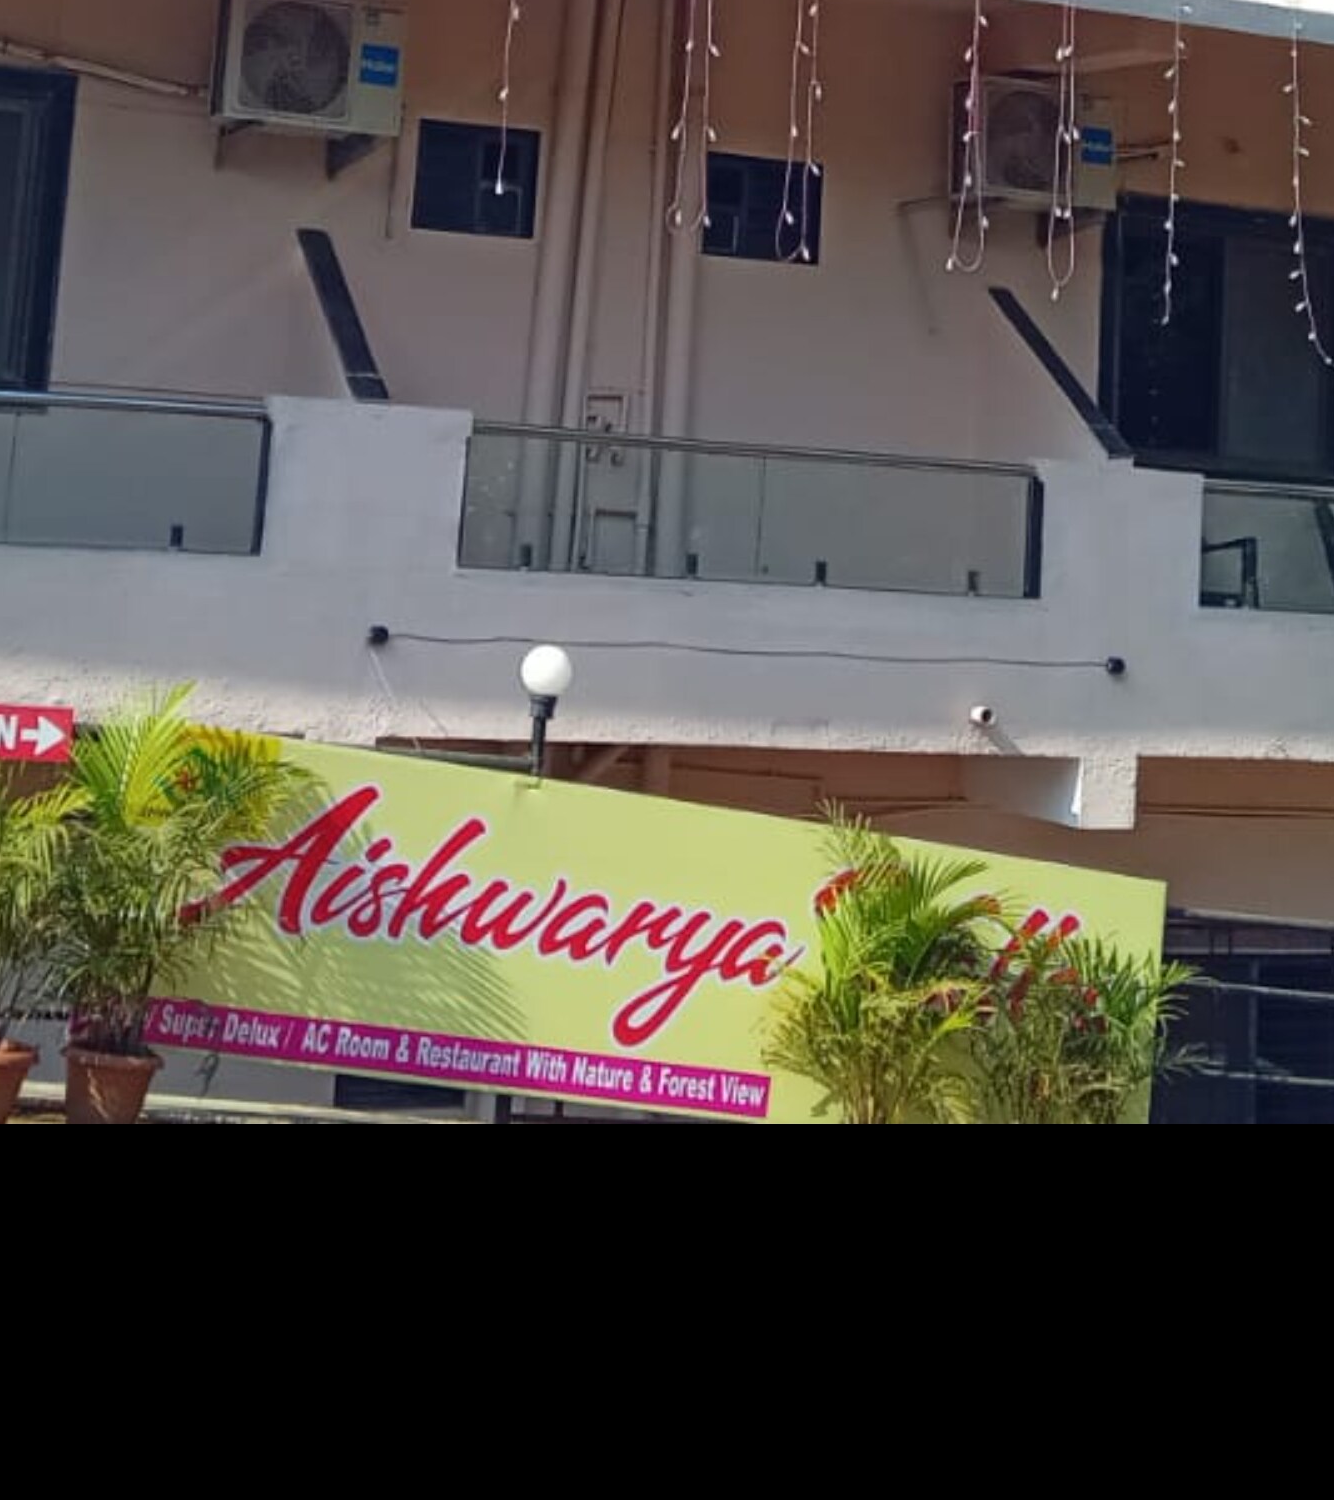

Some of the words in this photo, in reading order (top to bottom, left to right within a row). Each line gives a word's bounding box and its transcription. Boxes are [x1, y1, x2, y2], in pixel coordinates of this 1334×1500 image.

[175, 786, 803, 1047] Aishwarya
[302, 1022, 333, 1053] AC
[336, 1027, 389, 1059] Room
[395, 1034, 410, 1063] &
[416, 1036, 521, 1077] Restaurant
[526, 1050, 567, 1083] With
[572, 1056, 634, 1092] Nature
[639, 1063, 652, 1094] &
[658, 1067, 715, 1101] Forest
[719, 1075, 767, 1107] View
